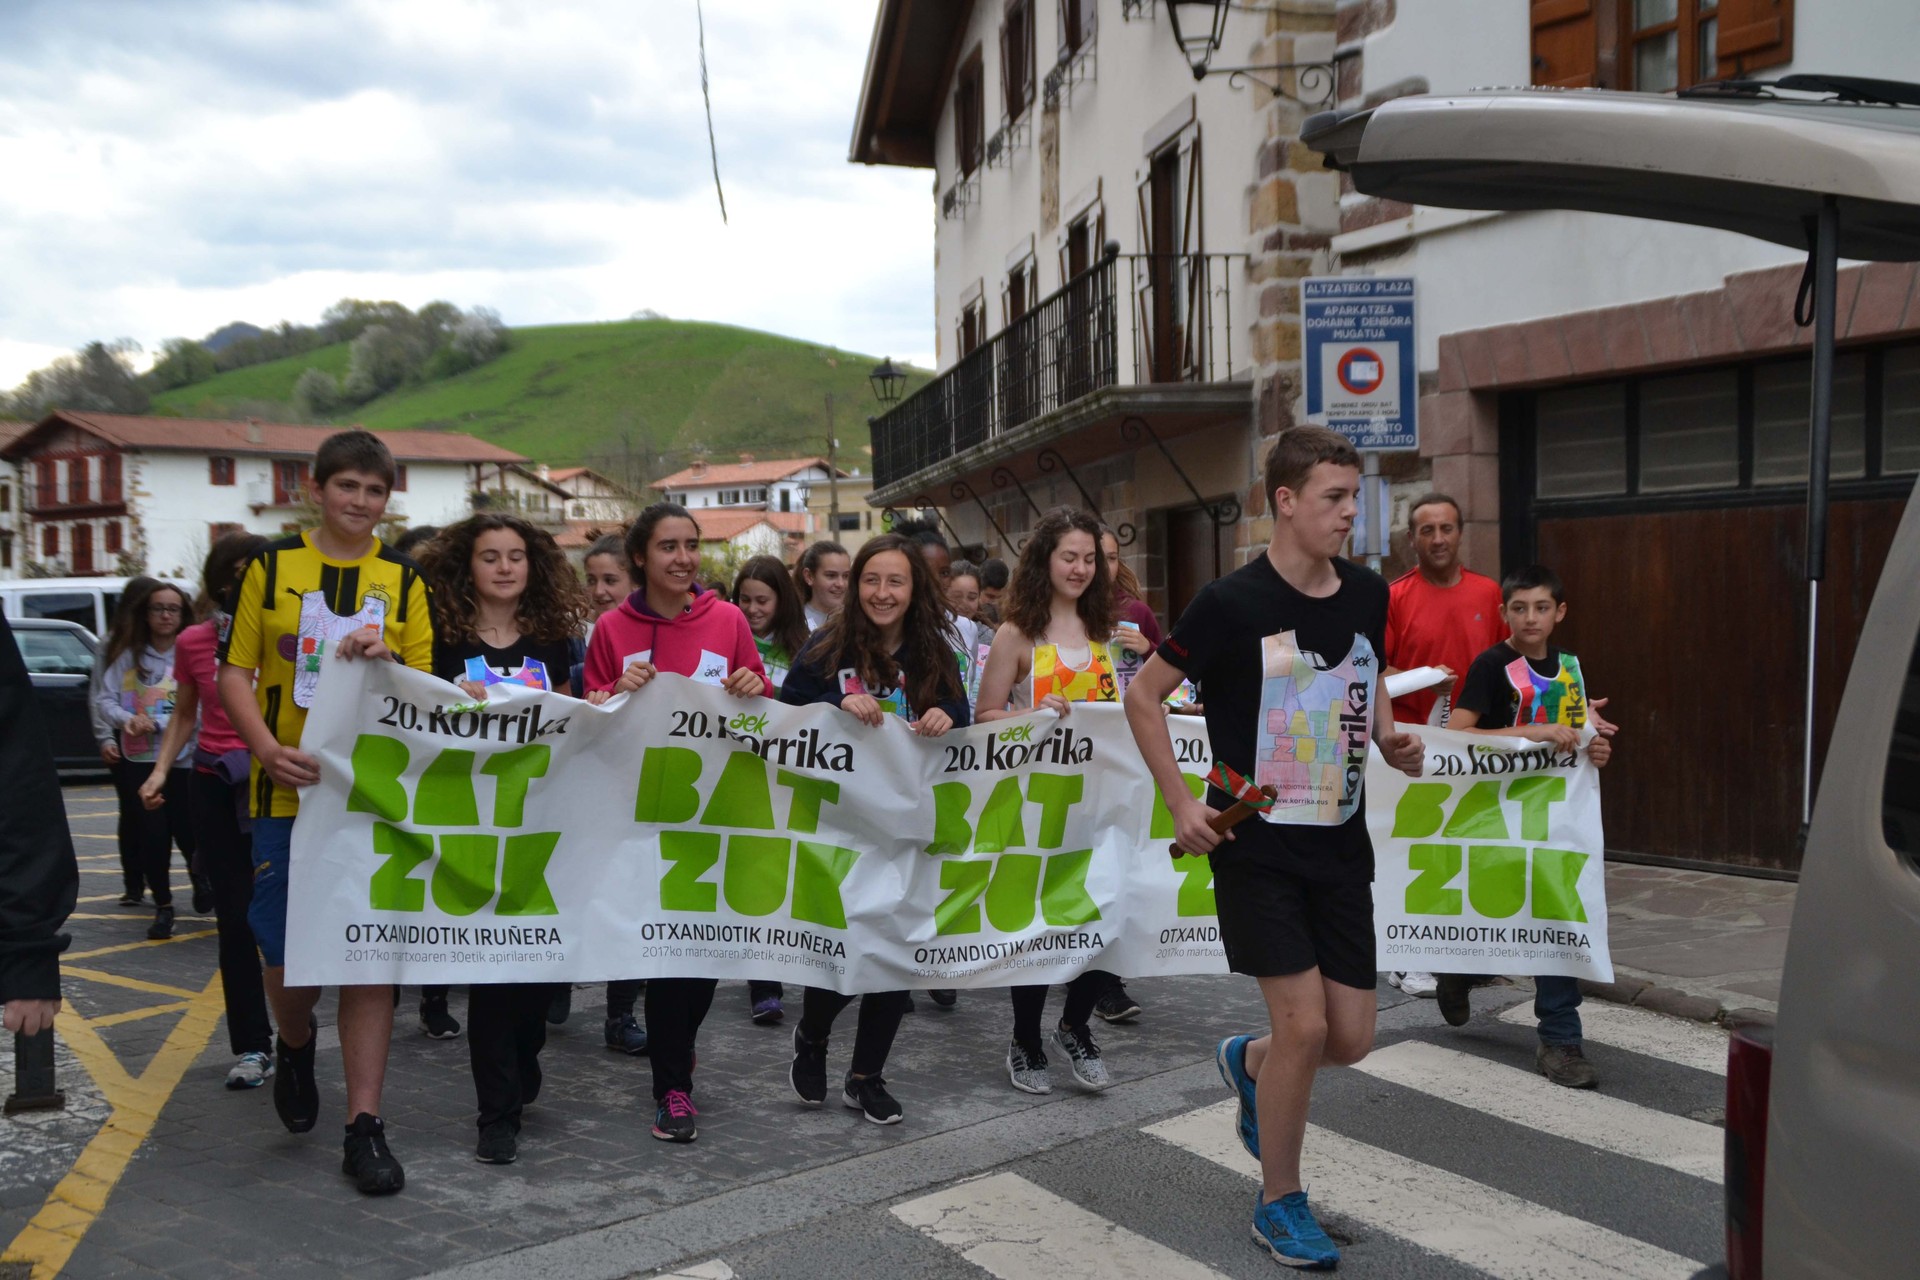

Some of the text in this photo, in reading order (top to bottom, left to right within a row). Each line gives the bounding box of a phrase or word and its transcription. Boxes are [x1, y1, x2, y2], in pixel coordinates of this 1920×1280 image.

[1306, 282, 1412, 294] ALTZATEKO PLAZA
[1307, 316, 1412, 328] DOHAINIK DENBORA
[1324, 304, 1395, 315] APARKATZEA
[1333, 328, 1386, 339] MUGATUA
[1362, 434, 1414, 445] GRATUITO
[704, 666, 722, 677] aek
[1352, 655, 1371, 668] aek
[377, 695, 571, 744] 20. korrika
[1566, 682, 1584, 730] rika
[729, 711, 769, 737] aek
[998, 721, 1035, 743] aek
[1267, 708, 1329, 736] BAT
[668, 710, 855, 773] 20. korrika
[944, 727, 1094, 773] 20. korrika
[1175, 737, 1209, 763] 20.
[1272, 736, 1338, 764] ZUK
[1337, 680, 1369, 808] korrika
[1432, 744, 1578, 776] 20. korrika
[346, 733, 551, 828] BAT
[634, 746, 840, 835] BAT
[924, 772, 1084, 857] BAT
[1390, 775, 1566, 842] BAT
[369, 821, 562, 917] ZUK
[659, 830, 862, 930] ZUK
[934, 848, 1103, 936] ZUK
[1405, 843, 1590, 923] ZUK
[345, 924, 562, 946] OTXANDIOTIK IRUÑERA
[641, 923, 846, 959] OTXANDIOTIK IRUÑERA
[1160, 926, 1223, 944] OTXANDI
[1386, 924, 1591, 948] OTXANDIOTIK IRUÑERA
[345, 949, 565, 965] 2017ko martxoaren 30etik apirilaren 9ra
[642, 946, 846, 976] 2017ko martxoaren 30etik apirilaren 9ra
[914, 939, 1025, 965] OTXANDIOTIK
[1156, 948, 1185, 959] 2017ko
[1386, 944, 1591, 964] 2017ko martxoaren 30etik apirilaren 9ra
[910, 968, 948, 980] 2017ko
[1003, 958, 1034, 970] 30etik
[1036, 954, 1084, 967] apirilaren
